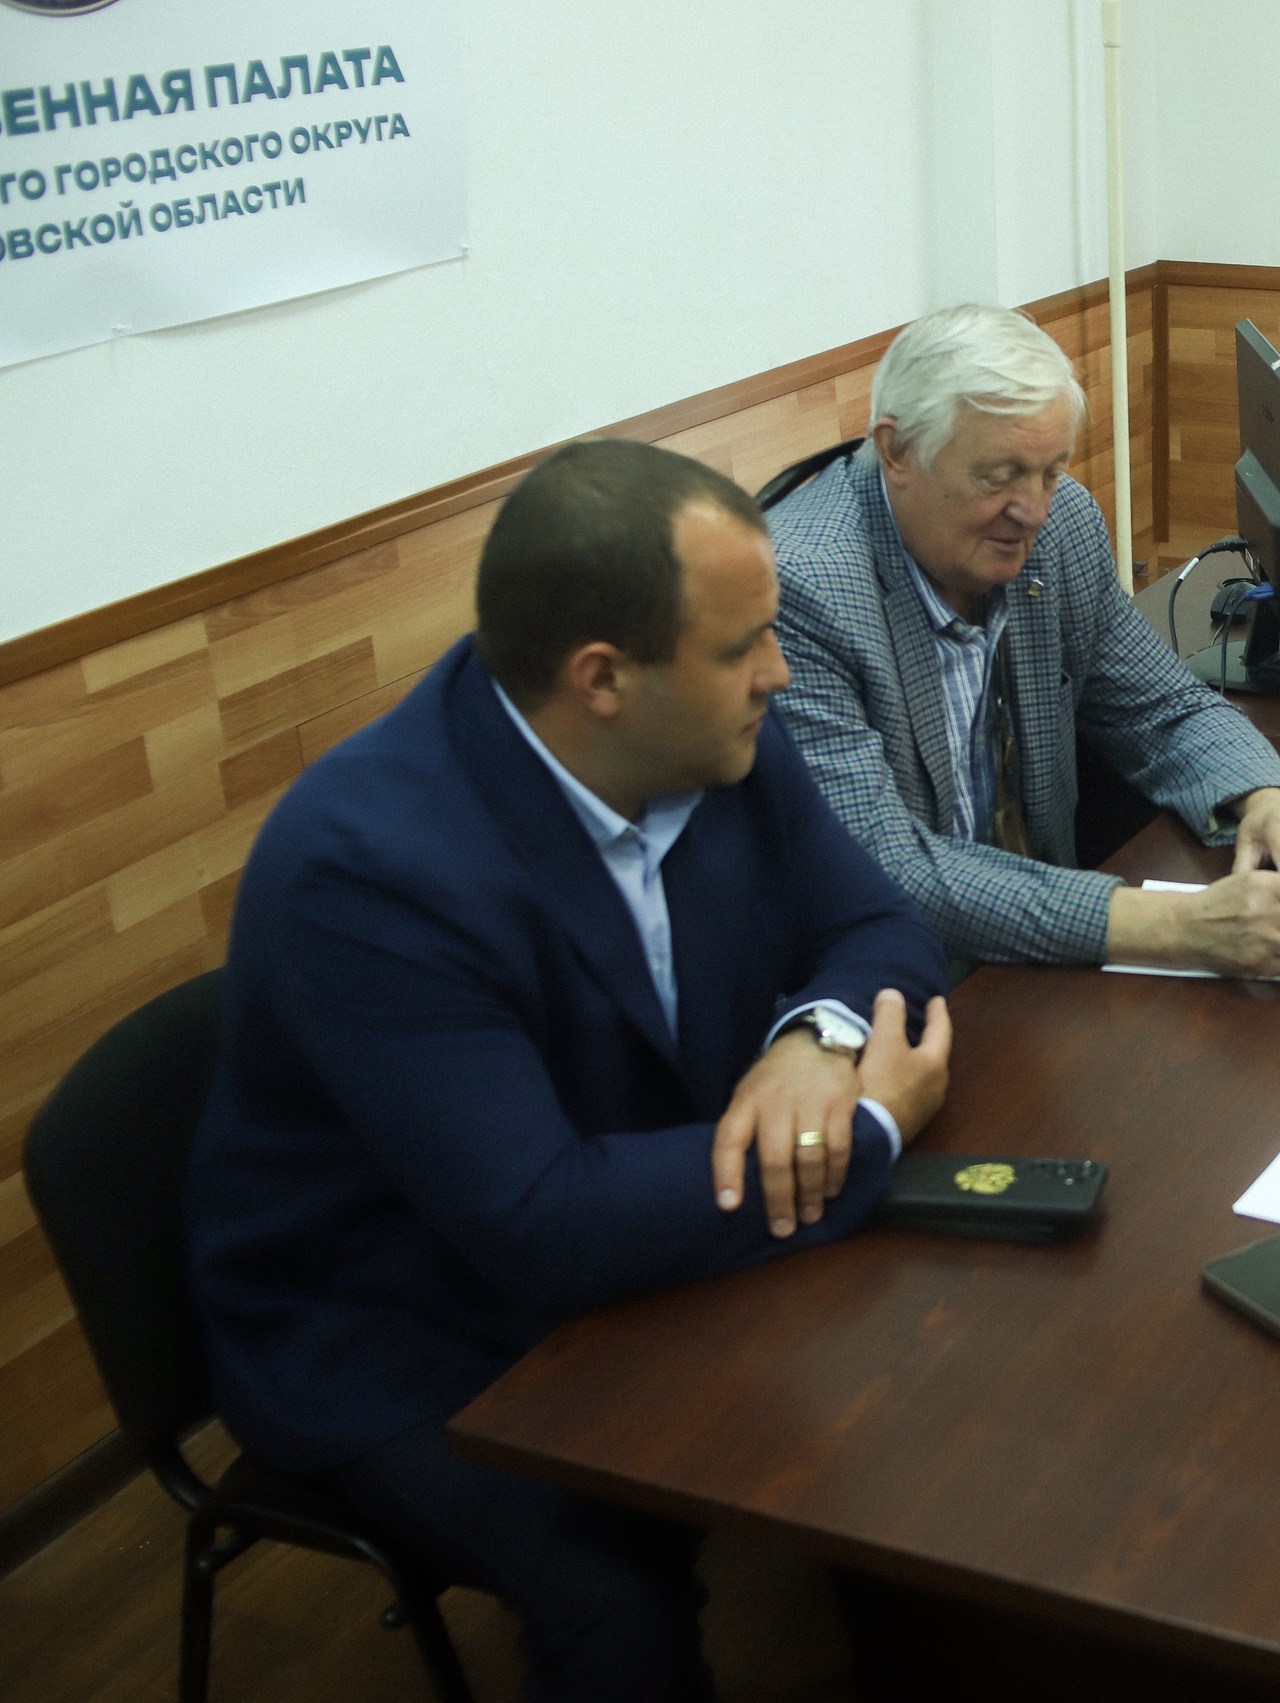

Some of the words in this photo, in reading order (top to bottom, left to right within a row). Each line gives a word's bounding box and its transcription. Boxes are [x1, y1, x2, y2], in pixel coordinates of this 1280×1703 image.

[0, 68, 195, 137] ЕННАЯ
[204, 45, 405, 108] ПАЛАТА
[53, 131, 282, 195] ГОРОДСКОГО
[288, 112, 410, 155] ОКРУГА
[0, 201, 144, 263] ВСКОЙ
[149, 177, 307, 232] ОБЛАСТИ
